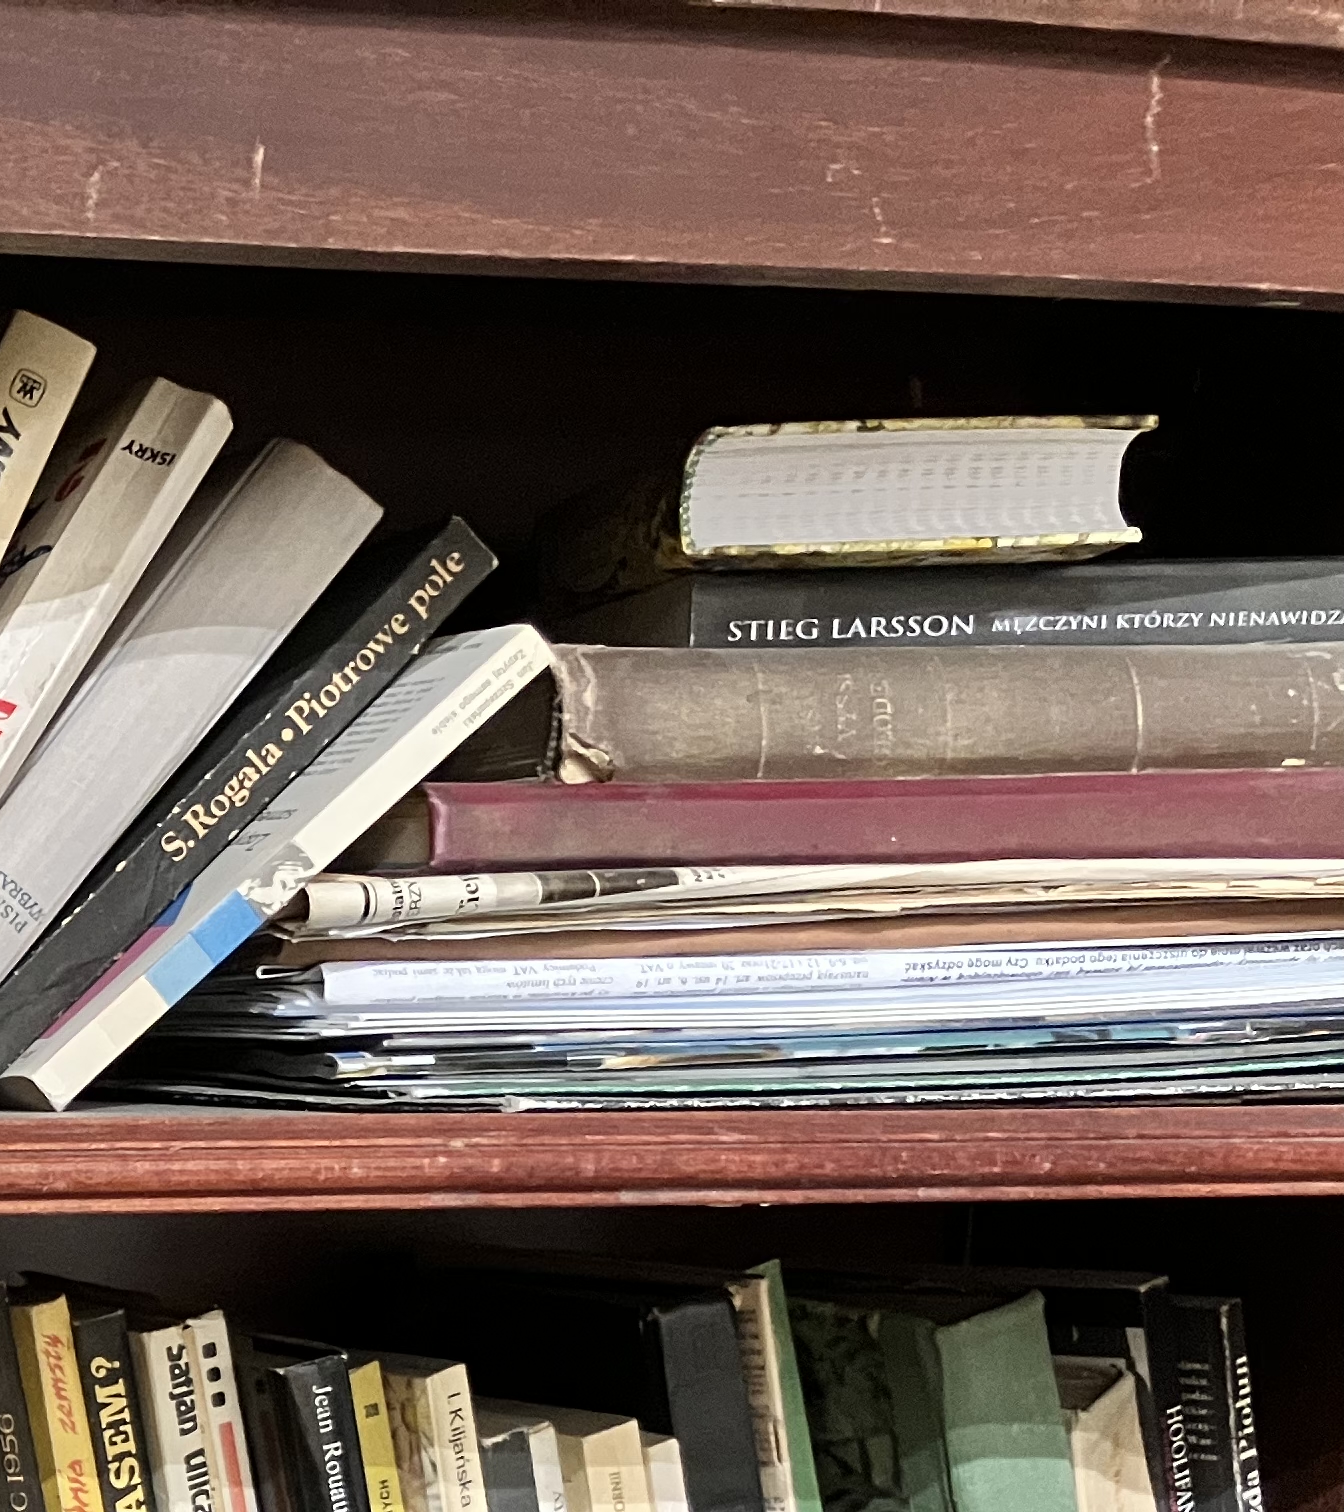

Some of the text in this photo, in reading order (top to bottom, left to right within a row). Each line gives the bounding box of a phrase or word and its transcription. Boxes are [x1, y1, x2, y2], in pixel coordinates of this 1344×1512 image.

[120, 439, 177, 469] ISKRY
[283, 549, 467, 737] Piotrowe pole
[726, 618, 821, 643] STIEG
[830, 613, 976, 640] LARSSON
[1115, 606, 1205, 630] KTÓRZY
[903, 957, 965, 976] odzyskać
[967, 956, 1004, 973] mogę
[1004, 955, 1030, 971] Czy
[166, 1343, 199, 1437] safjan
[312, 1384, 333, 1435] Jean
[448, 1406, 472, 1509] Kiljańska
